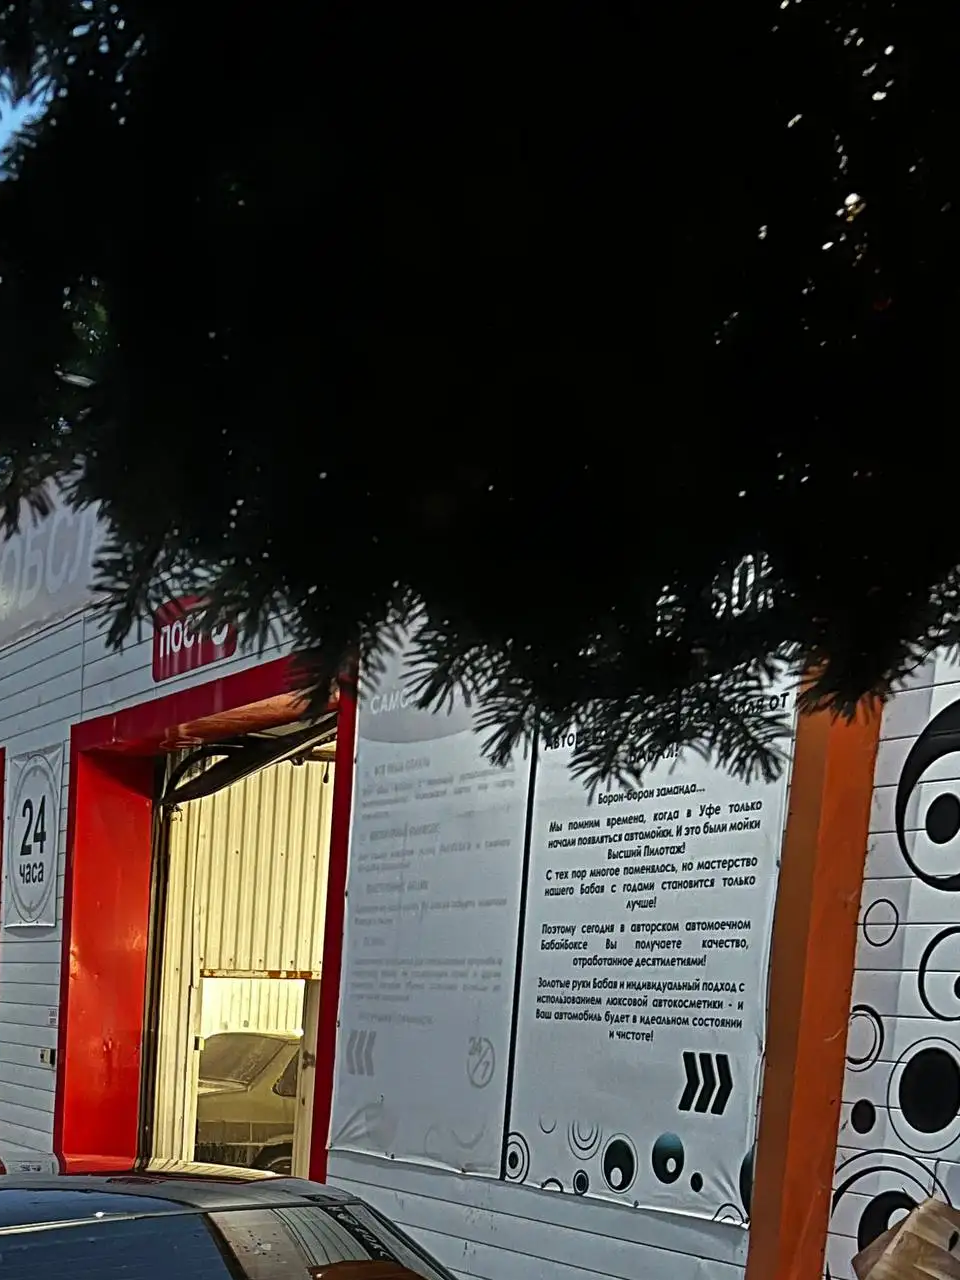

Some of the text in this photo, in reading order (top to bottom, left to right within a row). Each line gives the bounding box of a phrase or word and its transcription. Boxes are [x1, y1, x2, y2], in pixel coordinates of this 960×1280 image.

[568, 817, 600, 831] помним
[653, 809, 679, 822] когда
[699, 804, 720, 818] Уфе
[729, 800, 762, 813] только
[20, 795, 46, 856] 24
[548, 836, 576, 848] начали
[578, 832, 622, 846] появляться
[685, 825, 701, 836] это
[703, 822, 727, 834] были
[729, 819, 760, 831] мойки
[608, 842, 685, 860] Высший Пилотаж!
[20, 862, 44, 884] часа
[555, 870, 569, 880] тех
[572, 869, 587, 881] пор
[590, 866, 620, 878] многое
[697, 857, 757, 871] мастерство
[545, 886, 574, 897] нашего
[580, 883, 604, 894] Бабая
[623, 880, 655, 892] годами
[661, 877, 714, 890] становится
[722, 875, 755, 887] только
[626, 897, 656, 910] лучше!
[542, 924, 576, 936] Поэтому
[581, 923, 614, 934] сегодня
[631, 922, 679, 934] авторском
[686, 919, 751, 931] автомоечном
[635, 940, 681, 952] получаете
[573, 955, 706, 968] отработанное десятилетиями!
[538, 978, 570, 989] Золотые
[572, 980, 590, 992] руки
[626, 979, 699, 992] индивидуальный
[702, 983, 736, 993] подход
[537, 995, 601, 1005] использованием
[606, 995, 647, 1007] люксовой
[652, 997, 723, 1009] автокосметики
[536, 1009, 551, 1019] Ваш
[554, 1010, 601, 1022] автомобиль
[604, 1011, 629, 1024] будет
[640, 1015, 689, 1026] идеальном
[692, 1017, 742, 1029] состоянии
[616, 1031, 653, 1042] чистоте!
